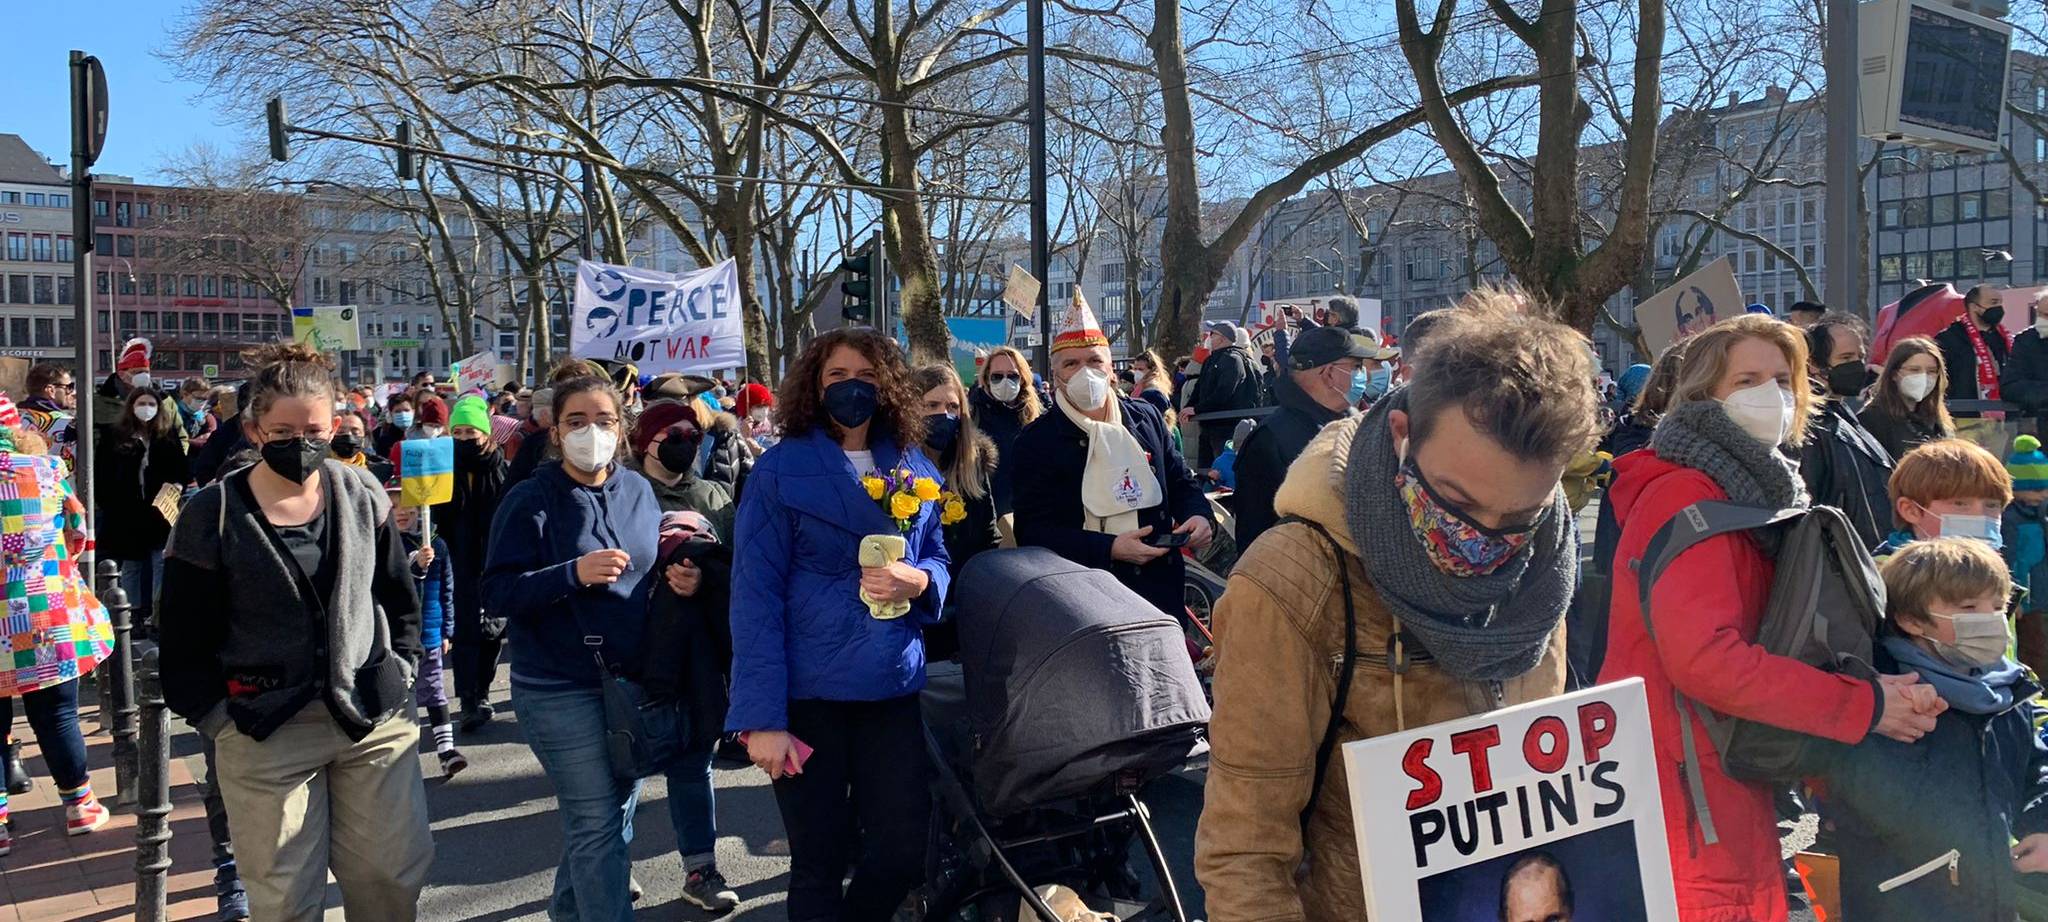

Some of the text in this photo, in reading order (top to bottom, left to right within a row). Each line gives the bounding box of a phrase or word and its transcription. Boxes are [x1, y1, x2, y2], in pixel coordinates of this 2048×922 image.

[0, 211, 20, 223] S
[626, 284, 728, 326] PEACE
[614, 335, 712, 362] NOT WAR
[1402, 701, 1617, 811] STOP
[1409, 760, 1626, 868] PUTIN'S
